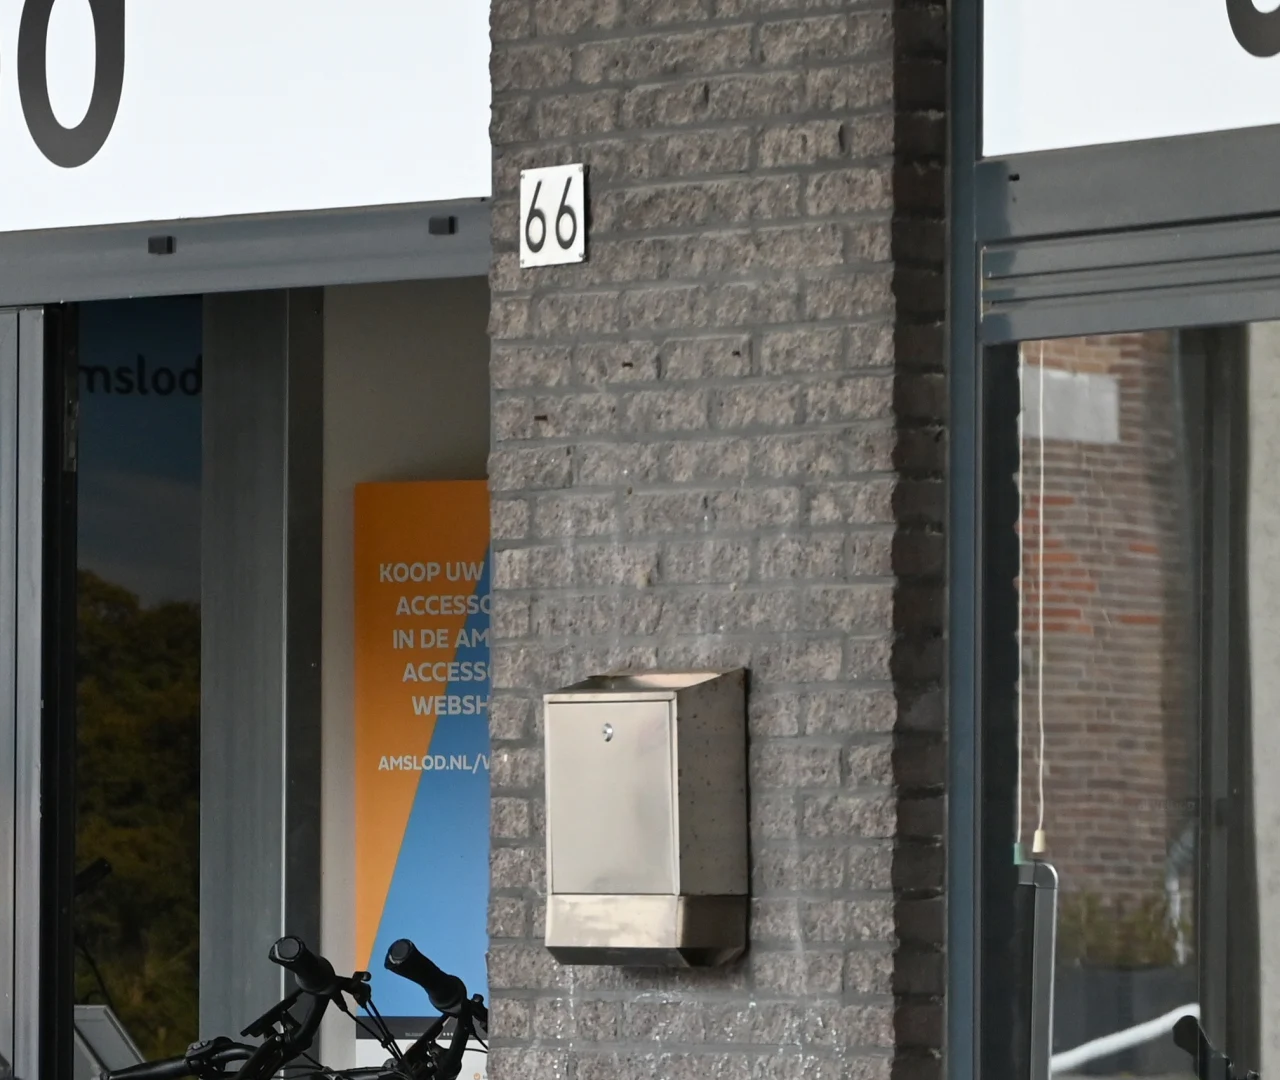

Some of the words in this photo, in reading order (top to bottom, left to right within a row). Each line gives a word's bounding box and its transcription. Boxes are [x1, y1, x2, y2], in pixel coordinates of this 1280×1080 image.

[525, 176, 577, 253] 66
[379, 562, 440, 583] KOOP
[446, 561, 484, 582] UW
[392, 629, 414, 649] IN
[420, 628, 449, 648] DE
[402, 661, 490, 682] ACCESS
